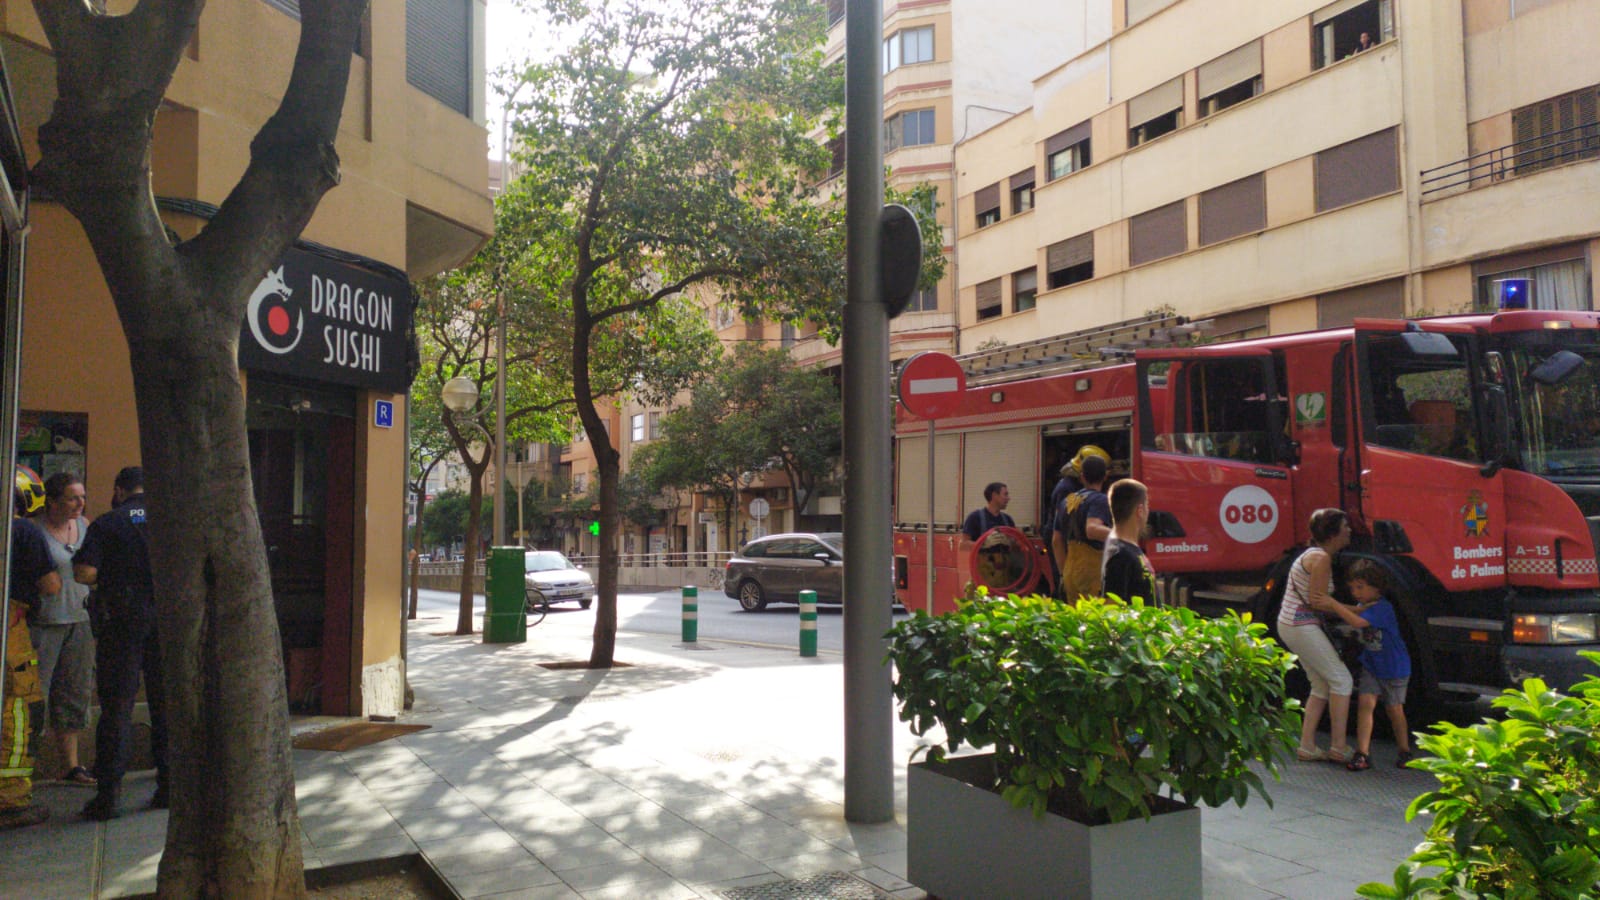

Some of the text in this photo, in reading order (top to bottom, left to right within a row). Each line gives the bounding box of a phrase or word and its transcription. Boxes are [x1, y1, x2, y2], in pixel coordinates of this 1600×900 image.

[311, 273, 392, 332] DRAGON
[323, 325, 380, 373] SUSHI
[380, 404, 388, 419] R
[1225, 504, 1274, 524] 080
[1155, 541, 1209, 553] Bombers
[1453, 543, 1503, 560] Bombers
[1451, 562, 1505, 579] de Palma
